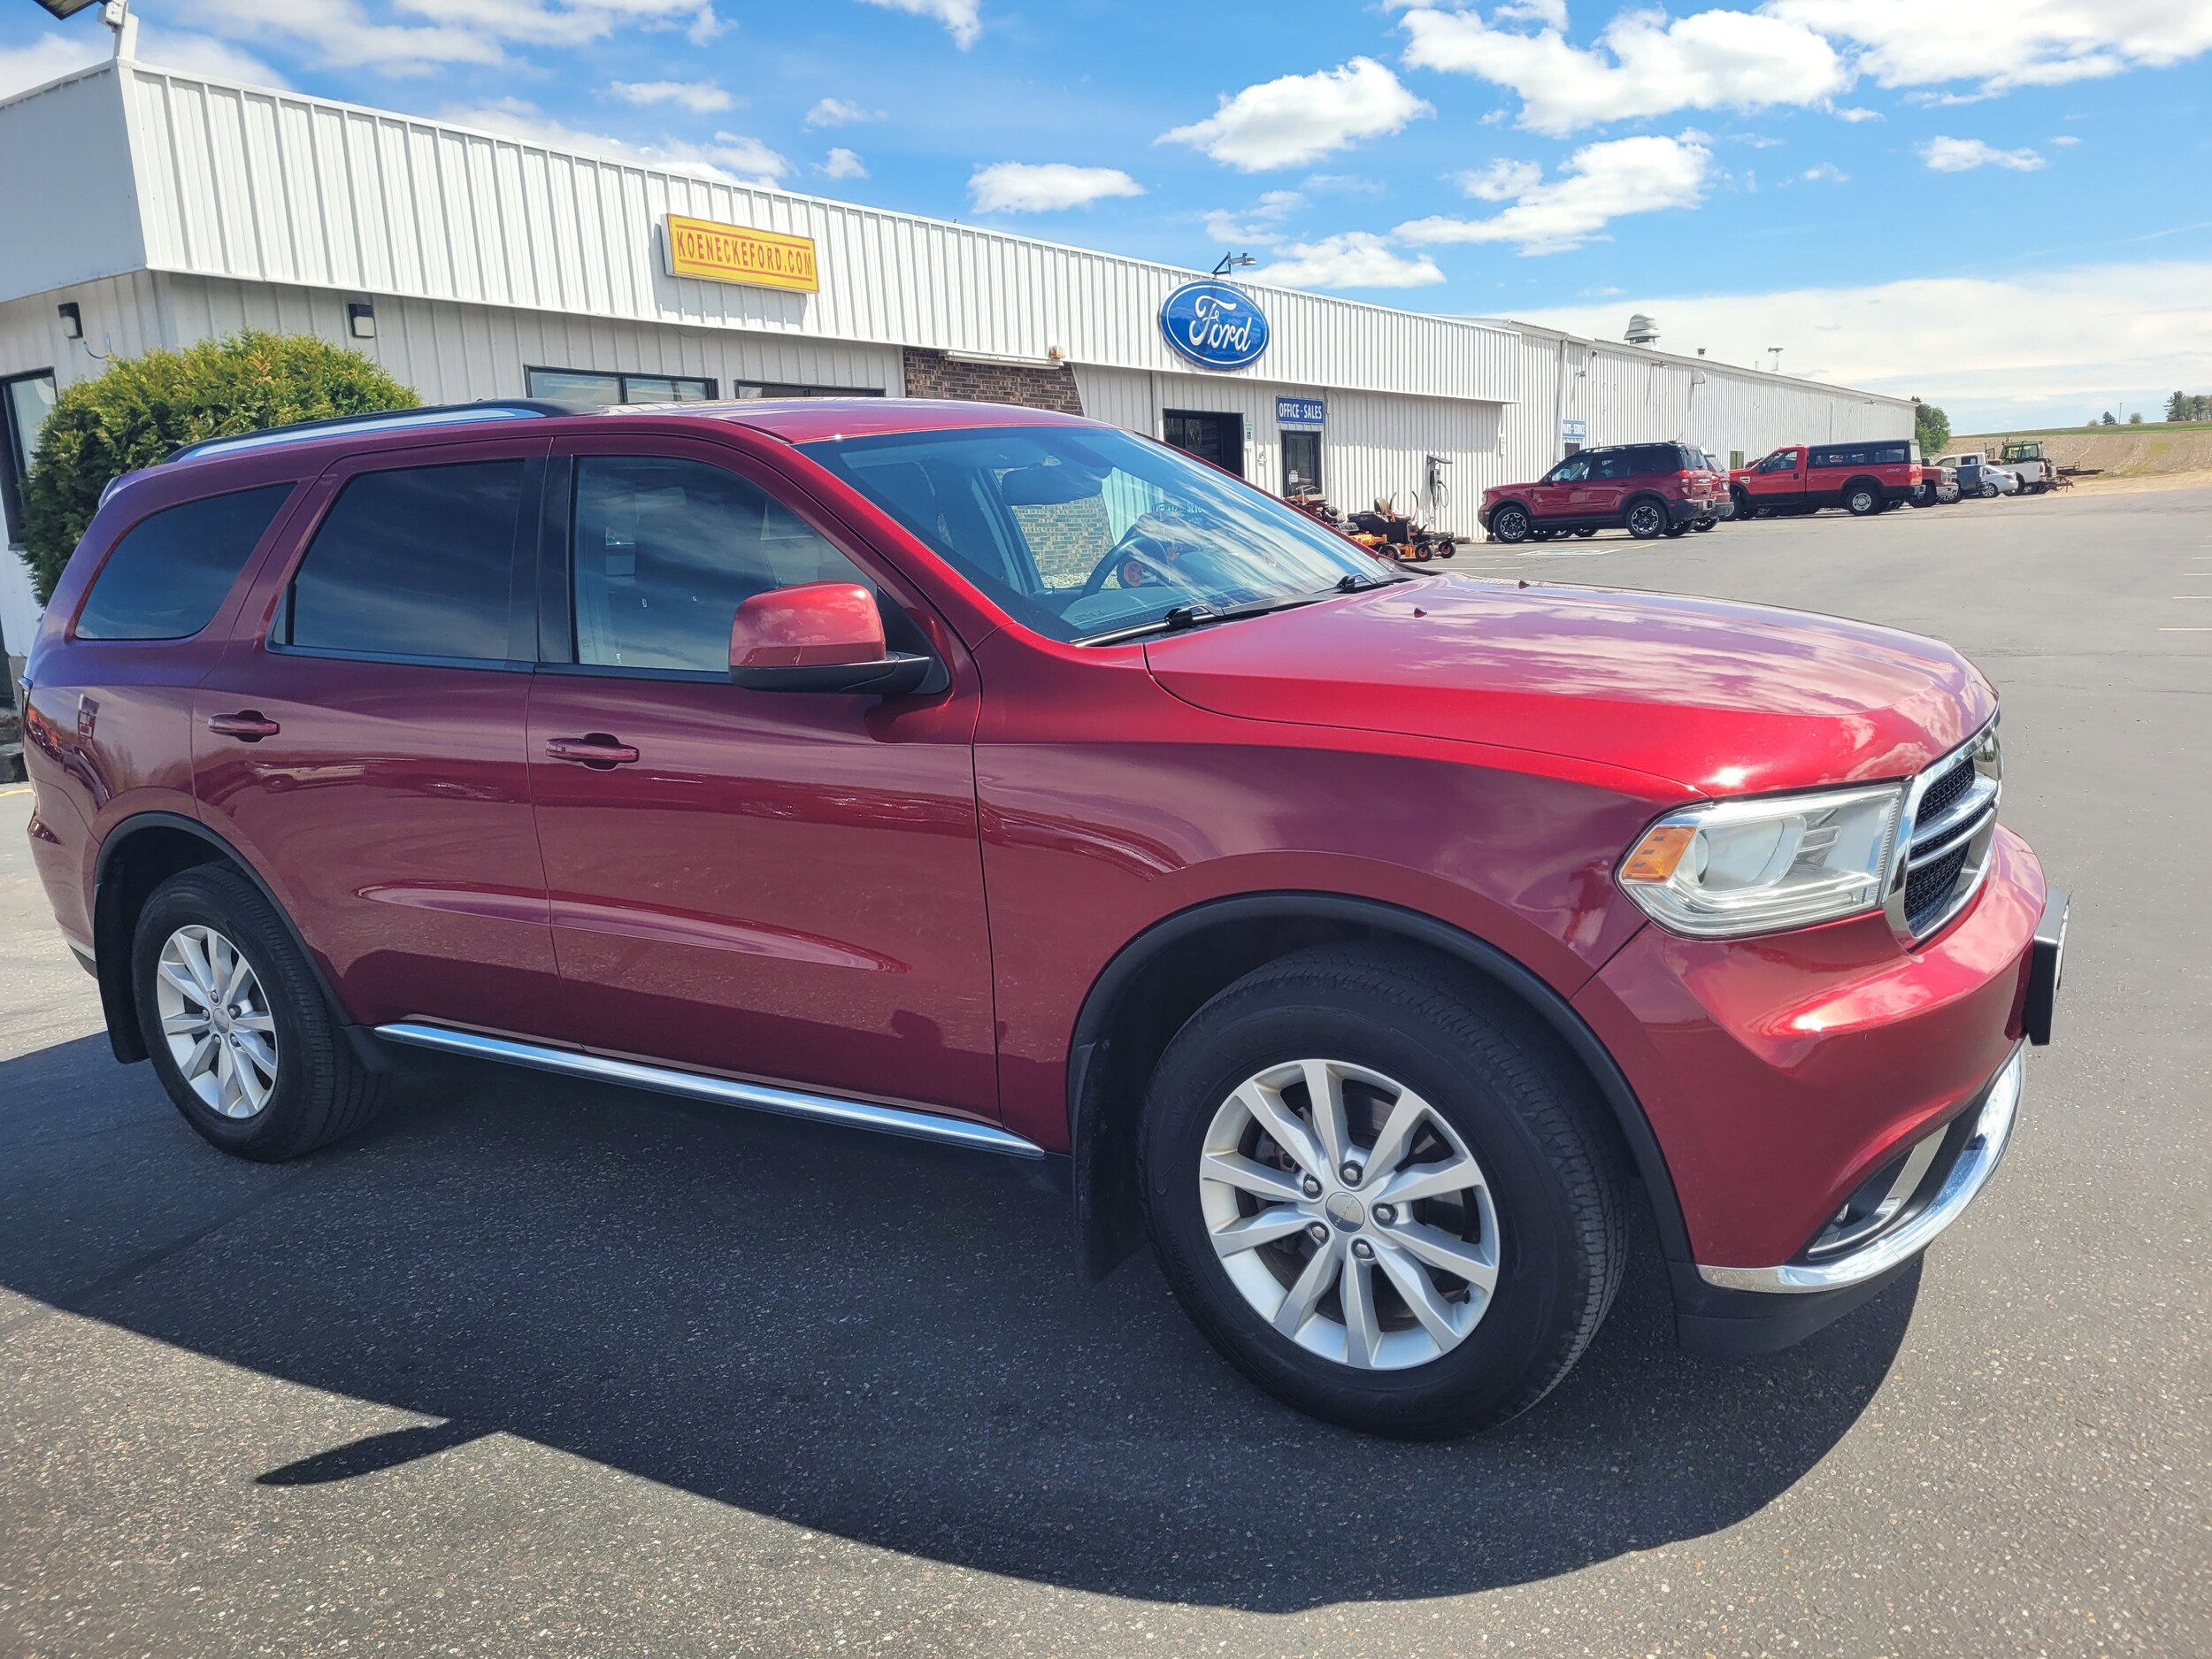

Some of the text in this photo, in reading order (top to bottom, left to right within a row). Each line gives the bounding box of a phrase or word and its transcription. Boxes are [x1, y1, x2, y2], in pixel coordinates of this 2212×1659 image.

[676, 230, 812, 276] KOENECKEFORD.COM
[1189, 295, 1252, 352] Ford
[1279, 403, 1300, 419] OFFICE
[1303, 404, 1322, 419] SALES
